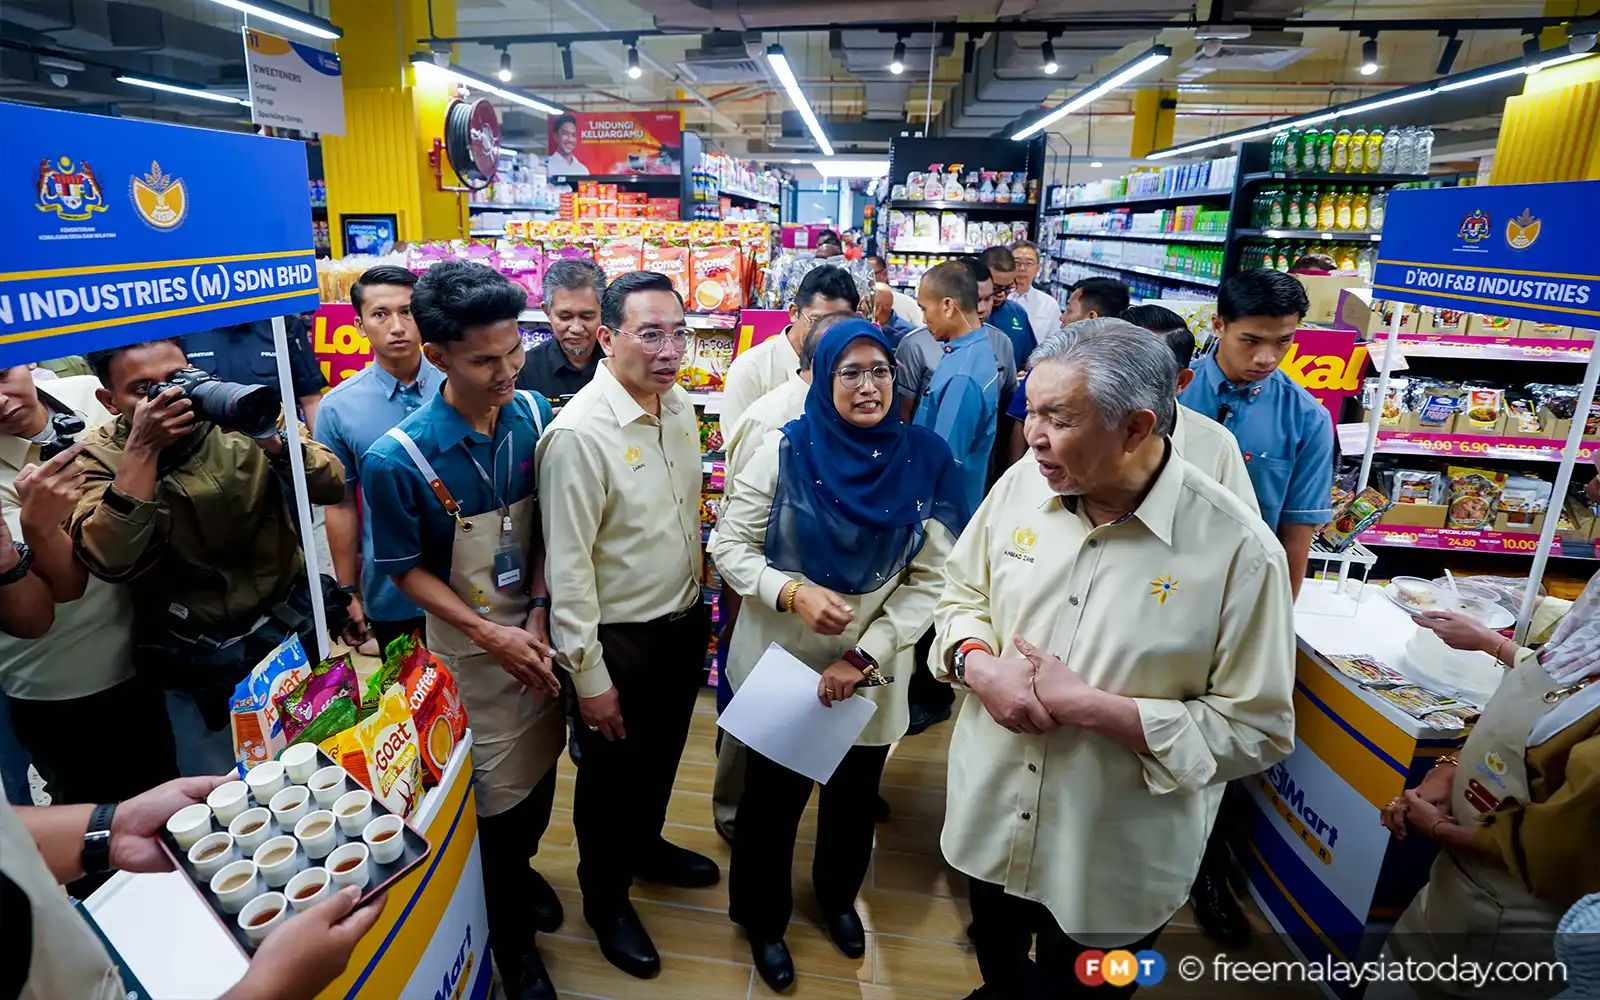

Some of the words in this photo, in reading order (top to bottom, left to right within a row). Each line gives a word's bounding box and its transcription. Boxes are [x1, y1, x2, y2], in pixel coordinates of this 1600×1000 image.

[253, 64, 302, 83] SWEETENERS
[588, 120, 634, 130] LINDUNGI
[581, 129, 644, 139] KELUARGAMU
[19, 276, 188, 322] INDUSTRIES
[191, 265, 230, 304] (M)
[233, 269, 275, 294] SDN
[276, 263, 313, 288] BHD
[1405, 268, 1444, 288] D'ROI
[1445, 274, 1476, 292] F&B
[1477, 279, 1591, 304] INDUSTRIES
[1278, 342, 1370, 391] kal
[1459, 441, 1491, 453] 6.90
[1502, 538, 1536, 551] 10.00
